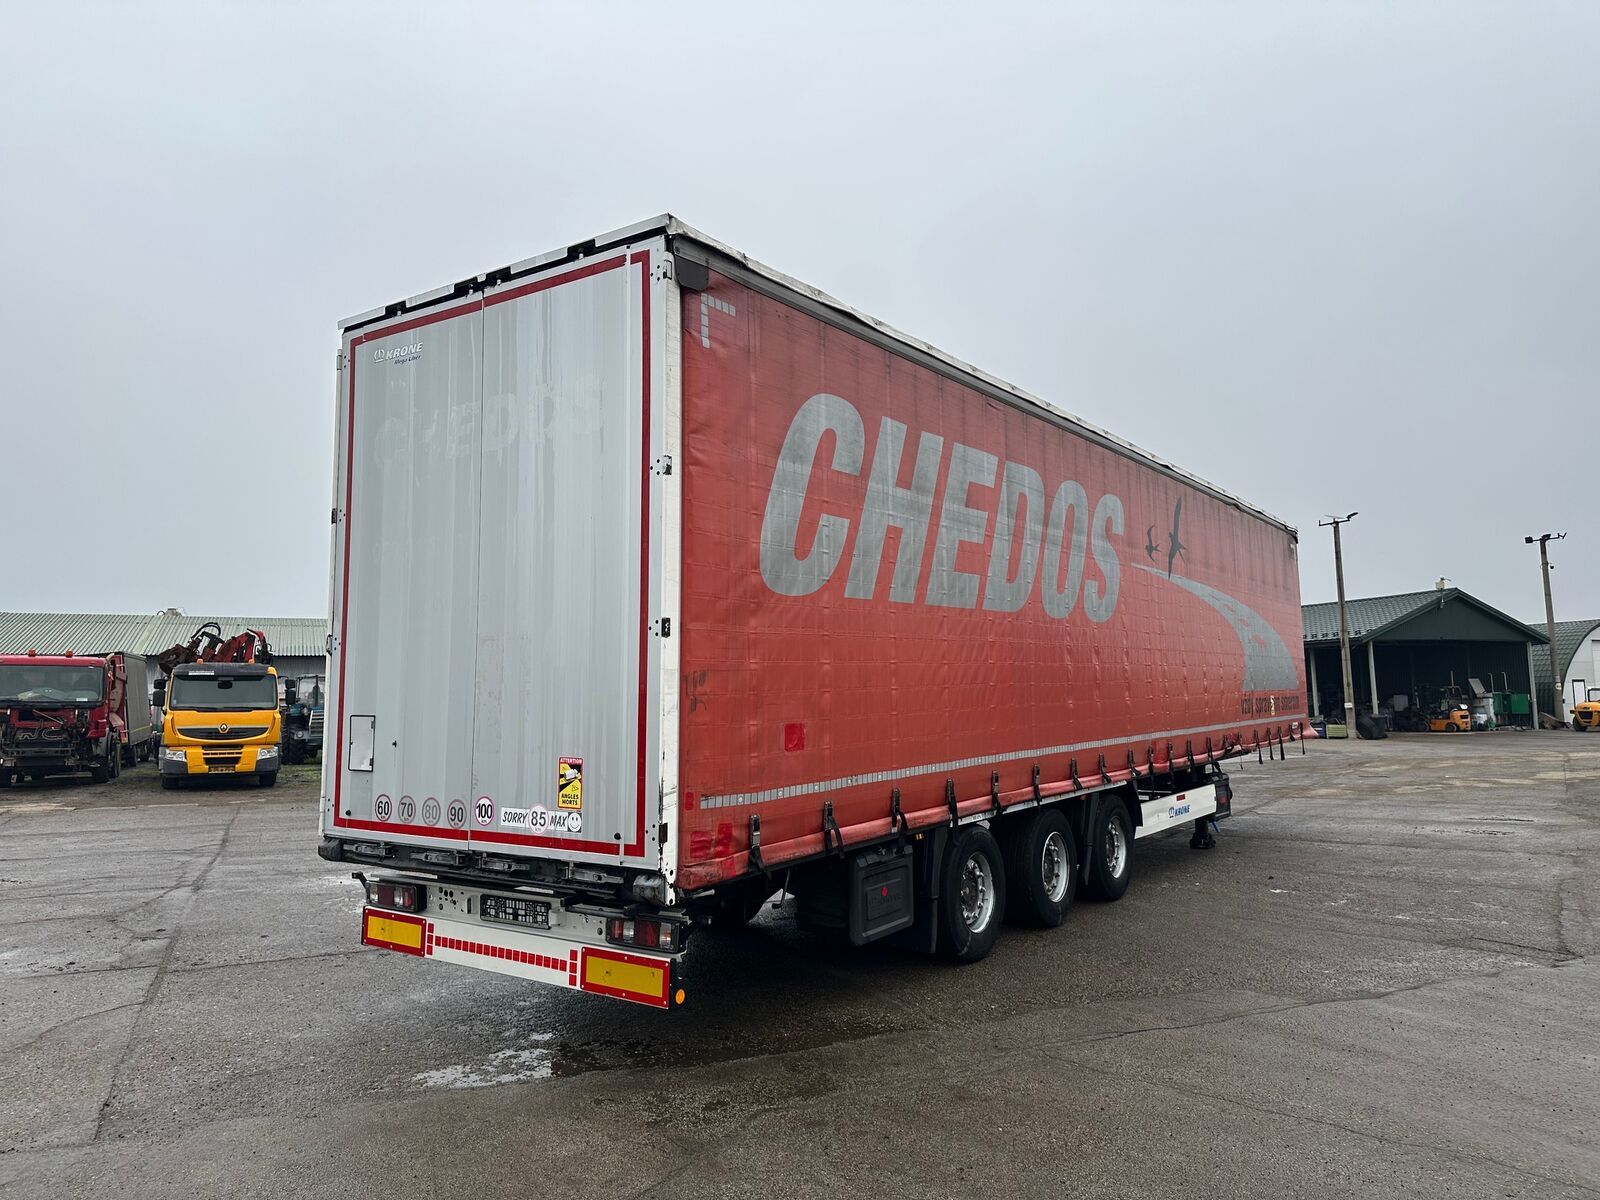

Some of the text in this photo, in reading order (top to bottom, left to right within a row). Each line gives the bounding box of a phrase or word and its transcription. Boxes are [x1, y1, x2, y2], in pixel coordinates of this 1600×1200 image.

[386, 342, 423, 360] KRONE
[759, 393, 1125, 622] CHEDOS
[377, 800, 390, 816] 60
[400, 802, 413, 818] 70
[424, 804, 437, 820] 80
[449, 806, 464, 823] 90
[476, 803, 493, 819] 100
[502, 811, 567, 828] SORRY 85 MAX
